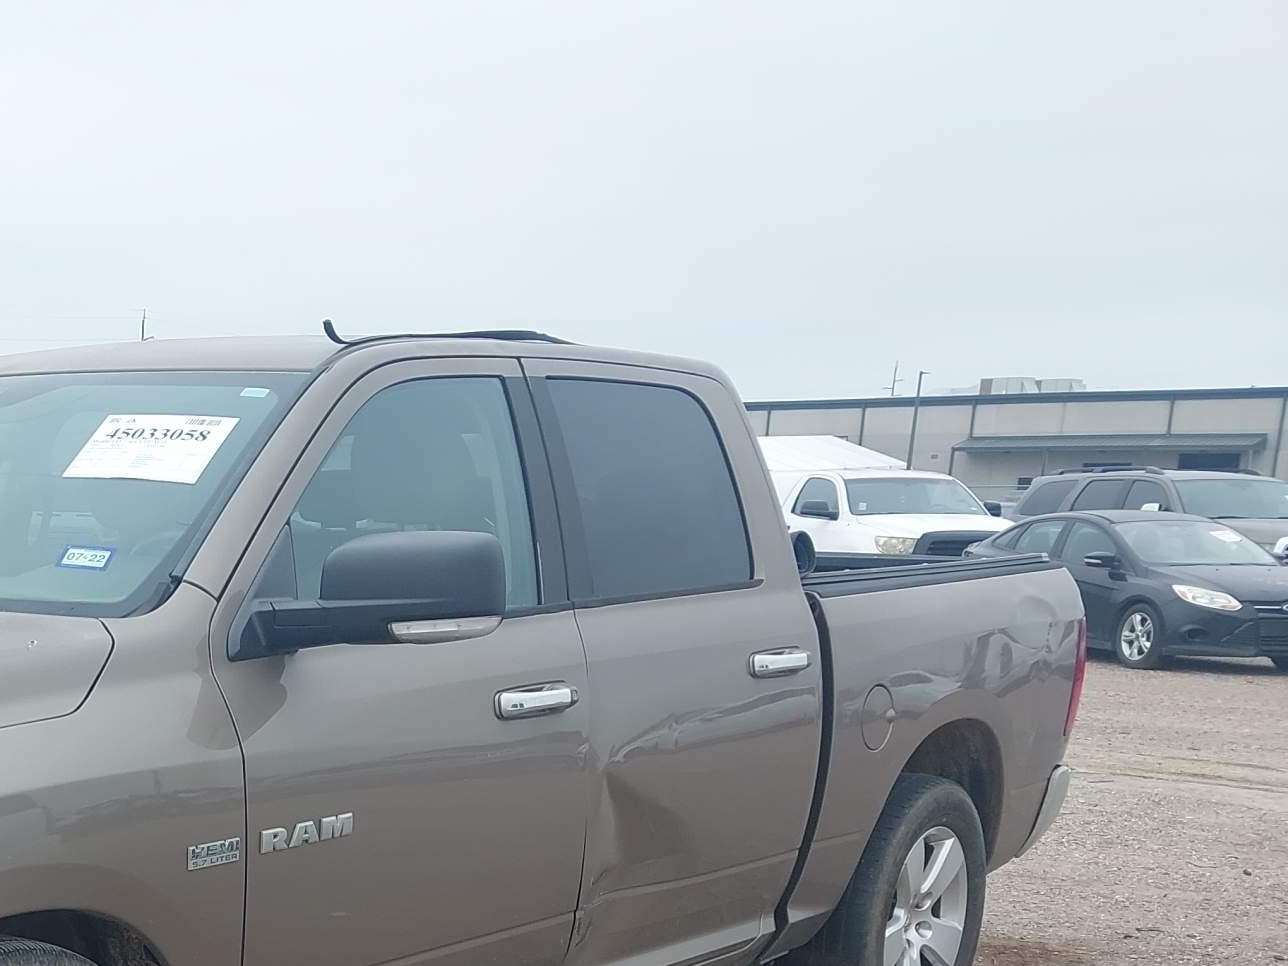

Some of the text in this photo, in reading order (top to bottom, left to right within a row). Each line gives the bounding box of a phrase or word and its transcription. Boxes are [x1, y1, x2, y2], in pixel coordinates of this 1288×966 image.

[106, 428, 211, 442] 45033058
[260, 812, 353, 854] RAM
[191, 839, 240, 859] HEMI
[192, 853, 238, 868] 5.7 LITER
